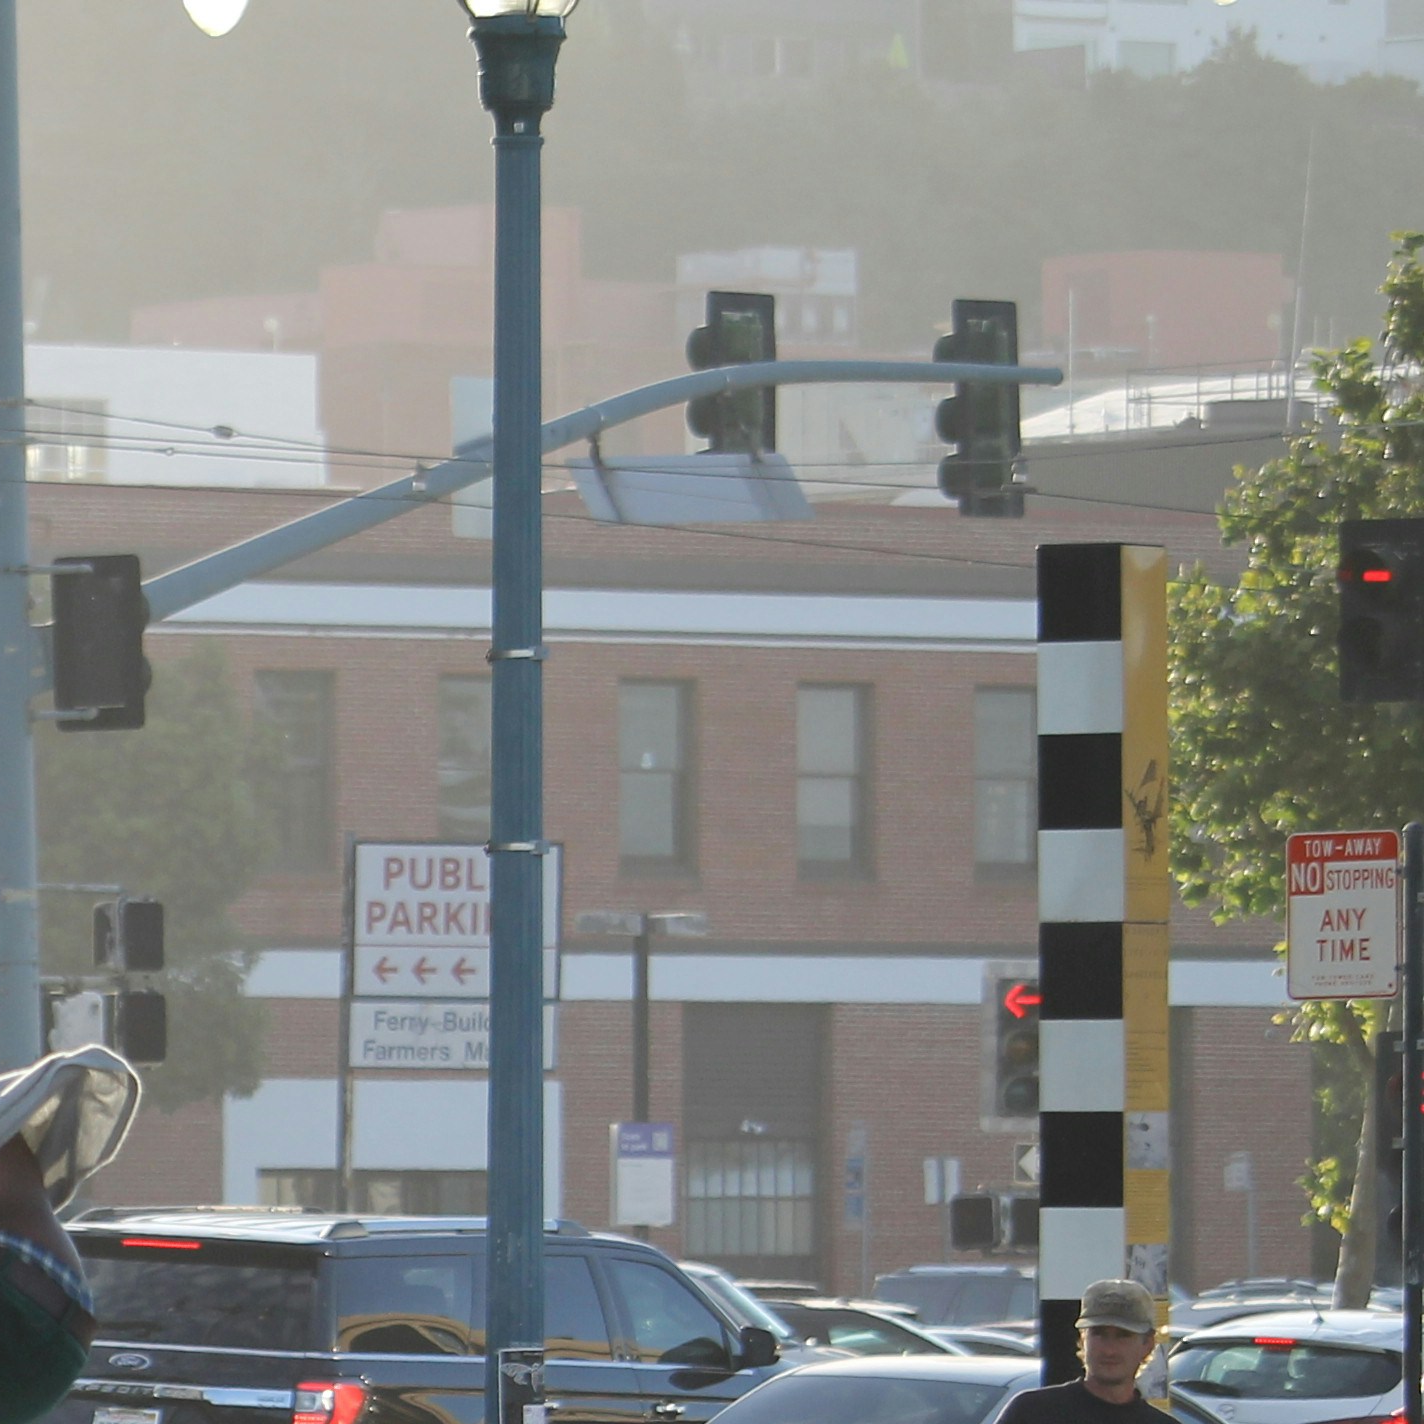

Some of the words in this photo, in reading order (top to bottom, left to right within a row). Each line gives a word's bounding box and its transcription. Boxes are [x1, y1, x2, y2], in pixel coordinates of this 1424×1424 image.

[1304, 838, 1382, 858] TOW-AWAY
[384, 857, 485, 891] PUBL
[1290, 862, 1320, 893] NO
[1326, 868, 1394, 892] STOPPING
[366, 901, 490, 936] PARKI
[1320, 908, 1367, 932] ANY
[1317, 938, 1371, 962] TIME
[374, 1010, 428, 1035] Ferry
[363, 1040, 450, 1061] Farmers
